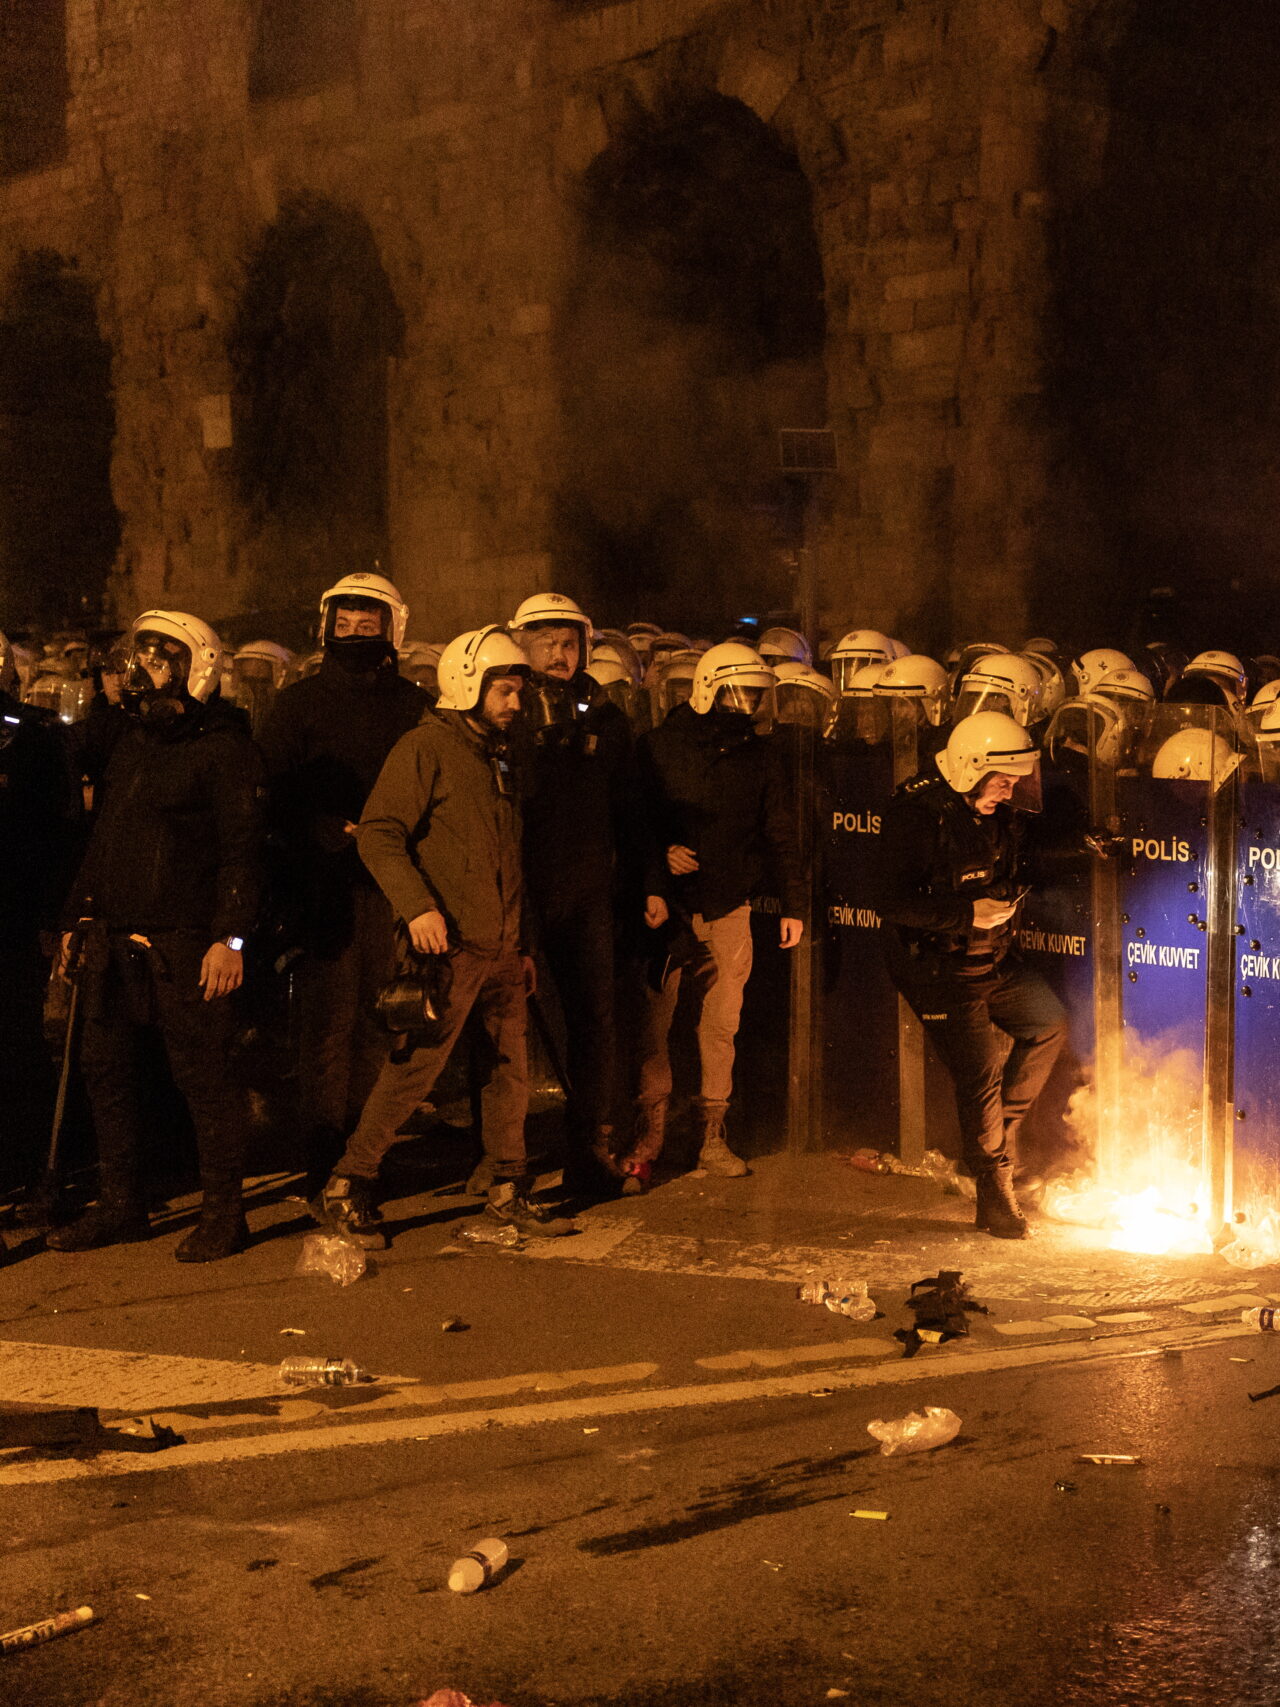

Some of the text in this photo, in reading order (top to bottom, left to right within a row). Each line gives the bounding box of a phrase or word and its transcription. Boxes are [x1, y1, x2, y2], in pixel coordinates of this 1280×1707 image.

[833, 810, 882, 834] POLİS
[1132, 836, 1189, 863] POLİS
[856, 907, 883, 929] KUVV
[1047, 933, 1086, 956] KUVVET
[1127, 940, 1200, 970] ÇEVİK KUVVET
[1240, 951, 1271, 981] ÇEVİK
